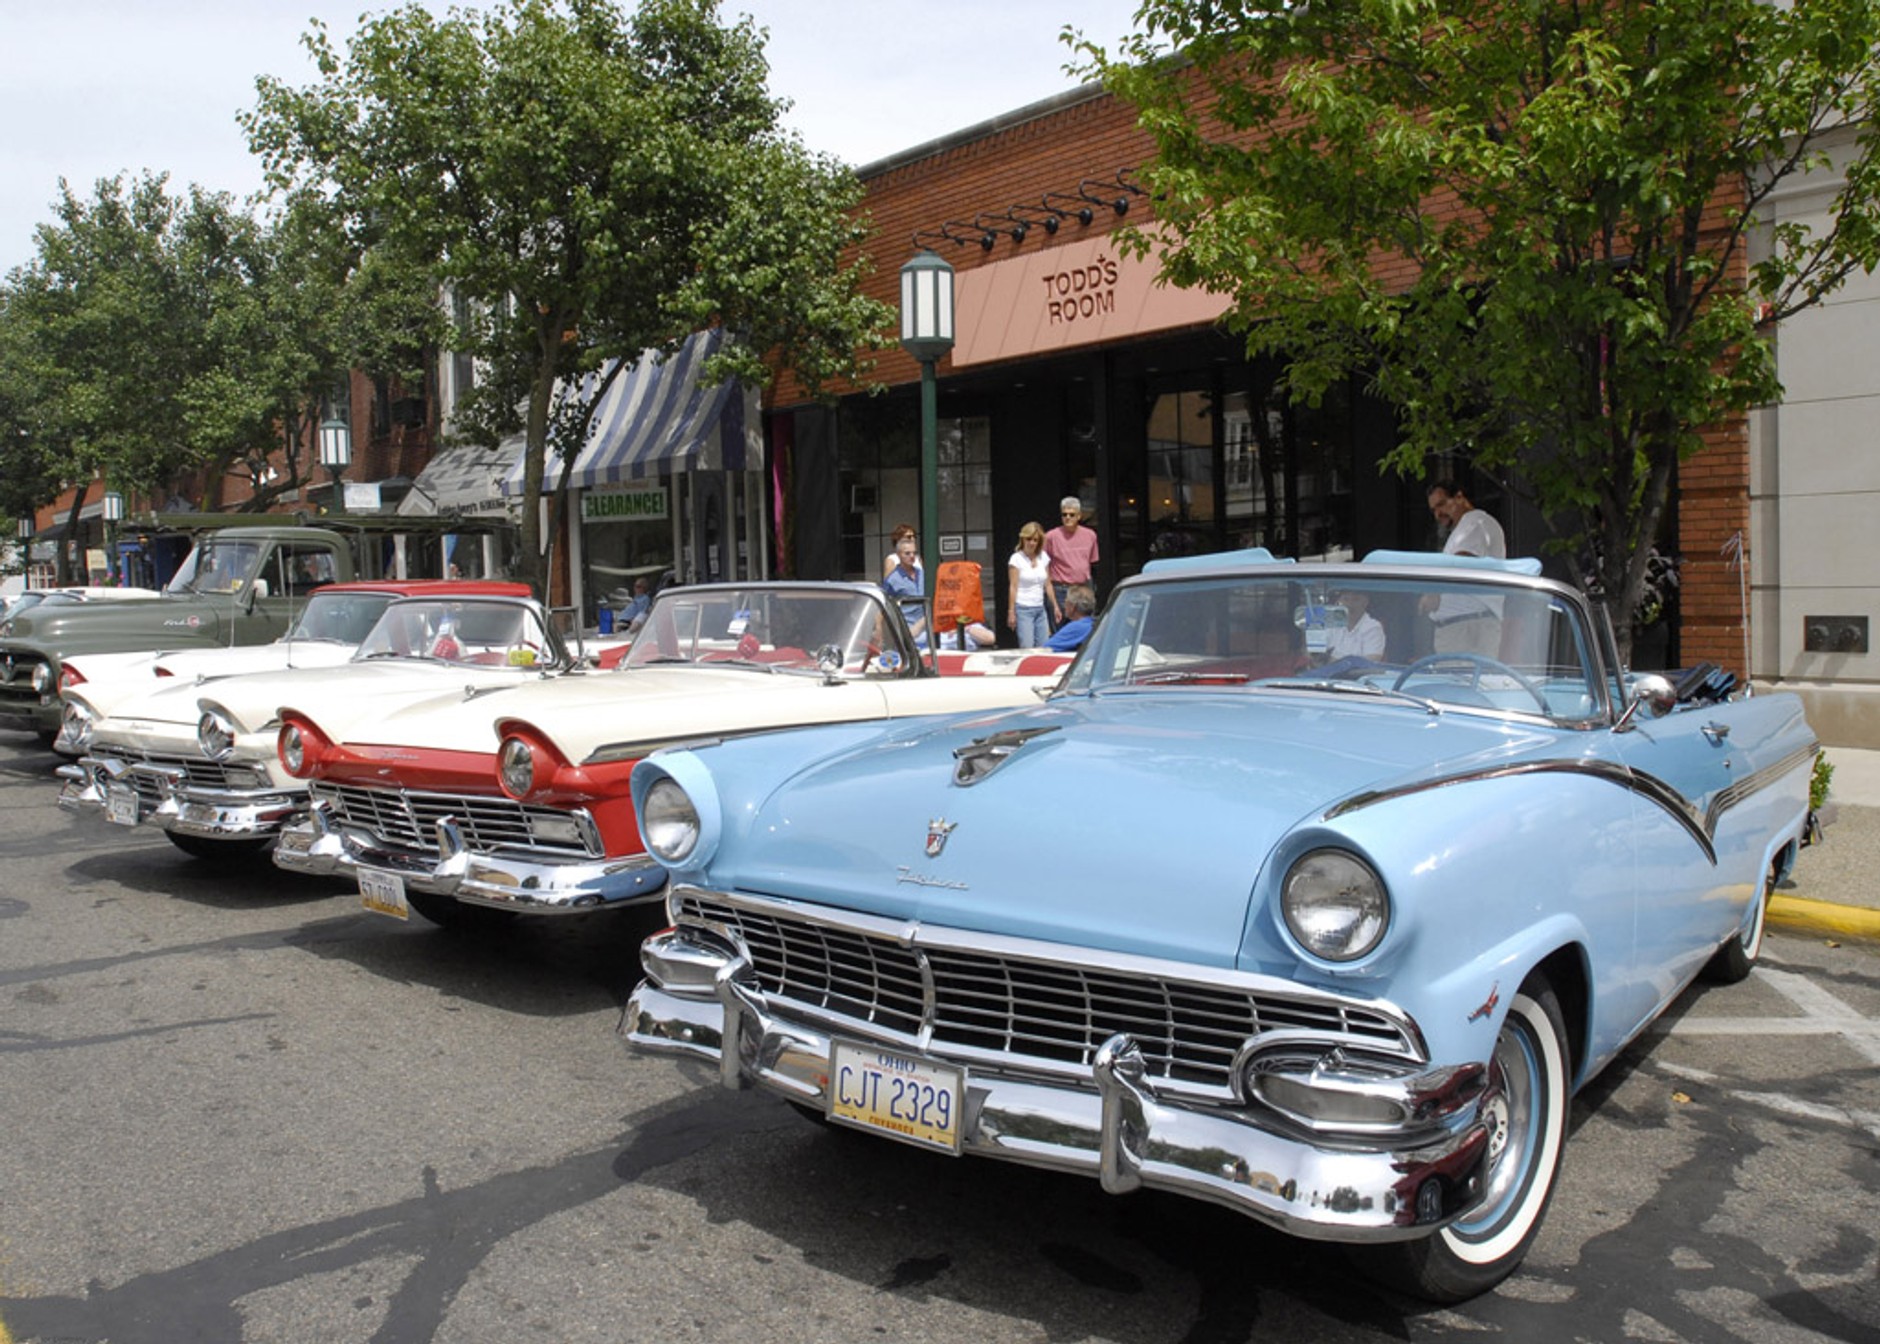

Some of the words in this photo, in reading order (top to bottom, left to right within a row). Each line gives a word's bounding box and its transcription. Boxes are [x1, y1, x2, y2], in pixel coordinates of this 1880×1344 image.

[1042, 254, 1118, 298] TODD'S
[1049, 289, 1115, 325] ROOM
[584, 491, 664, 517] CLEARANCE!
[877, 1053, 917, 1073] OHIO
[839, 1065, 882, 1112] CJT
[890, 1077, 951, 1130] 2329
